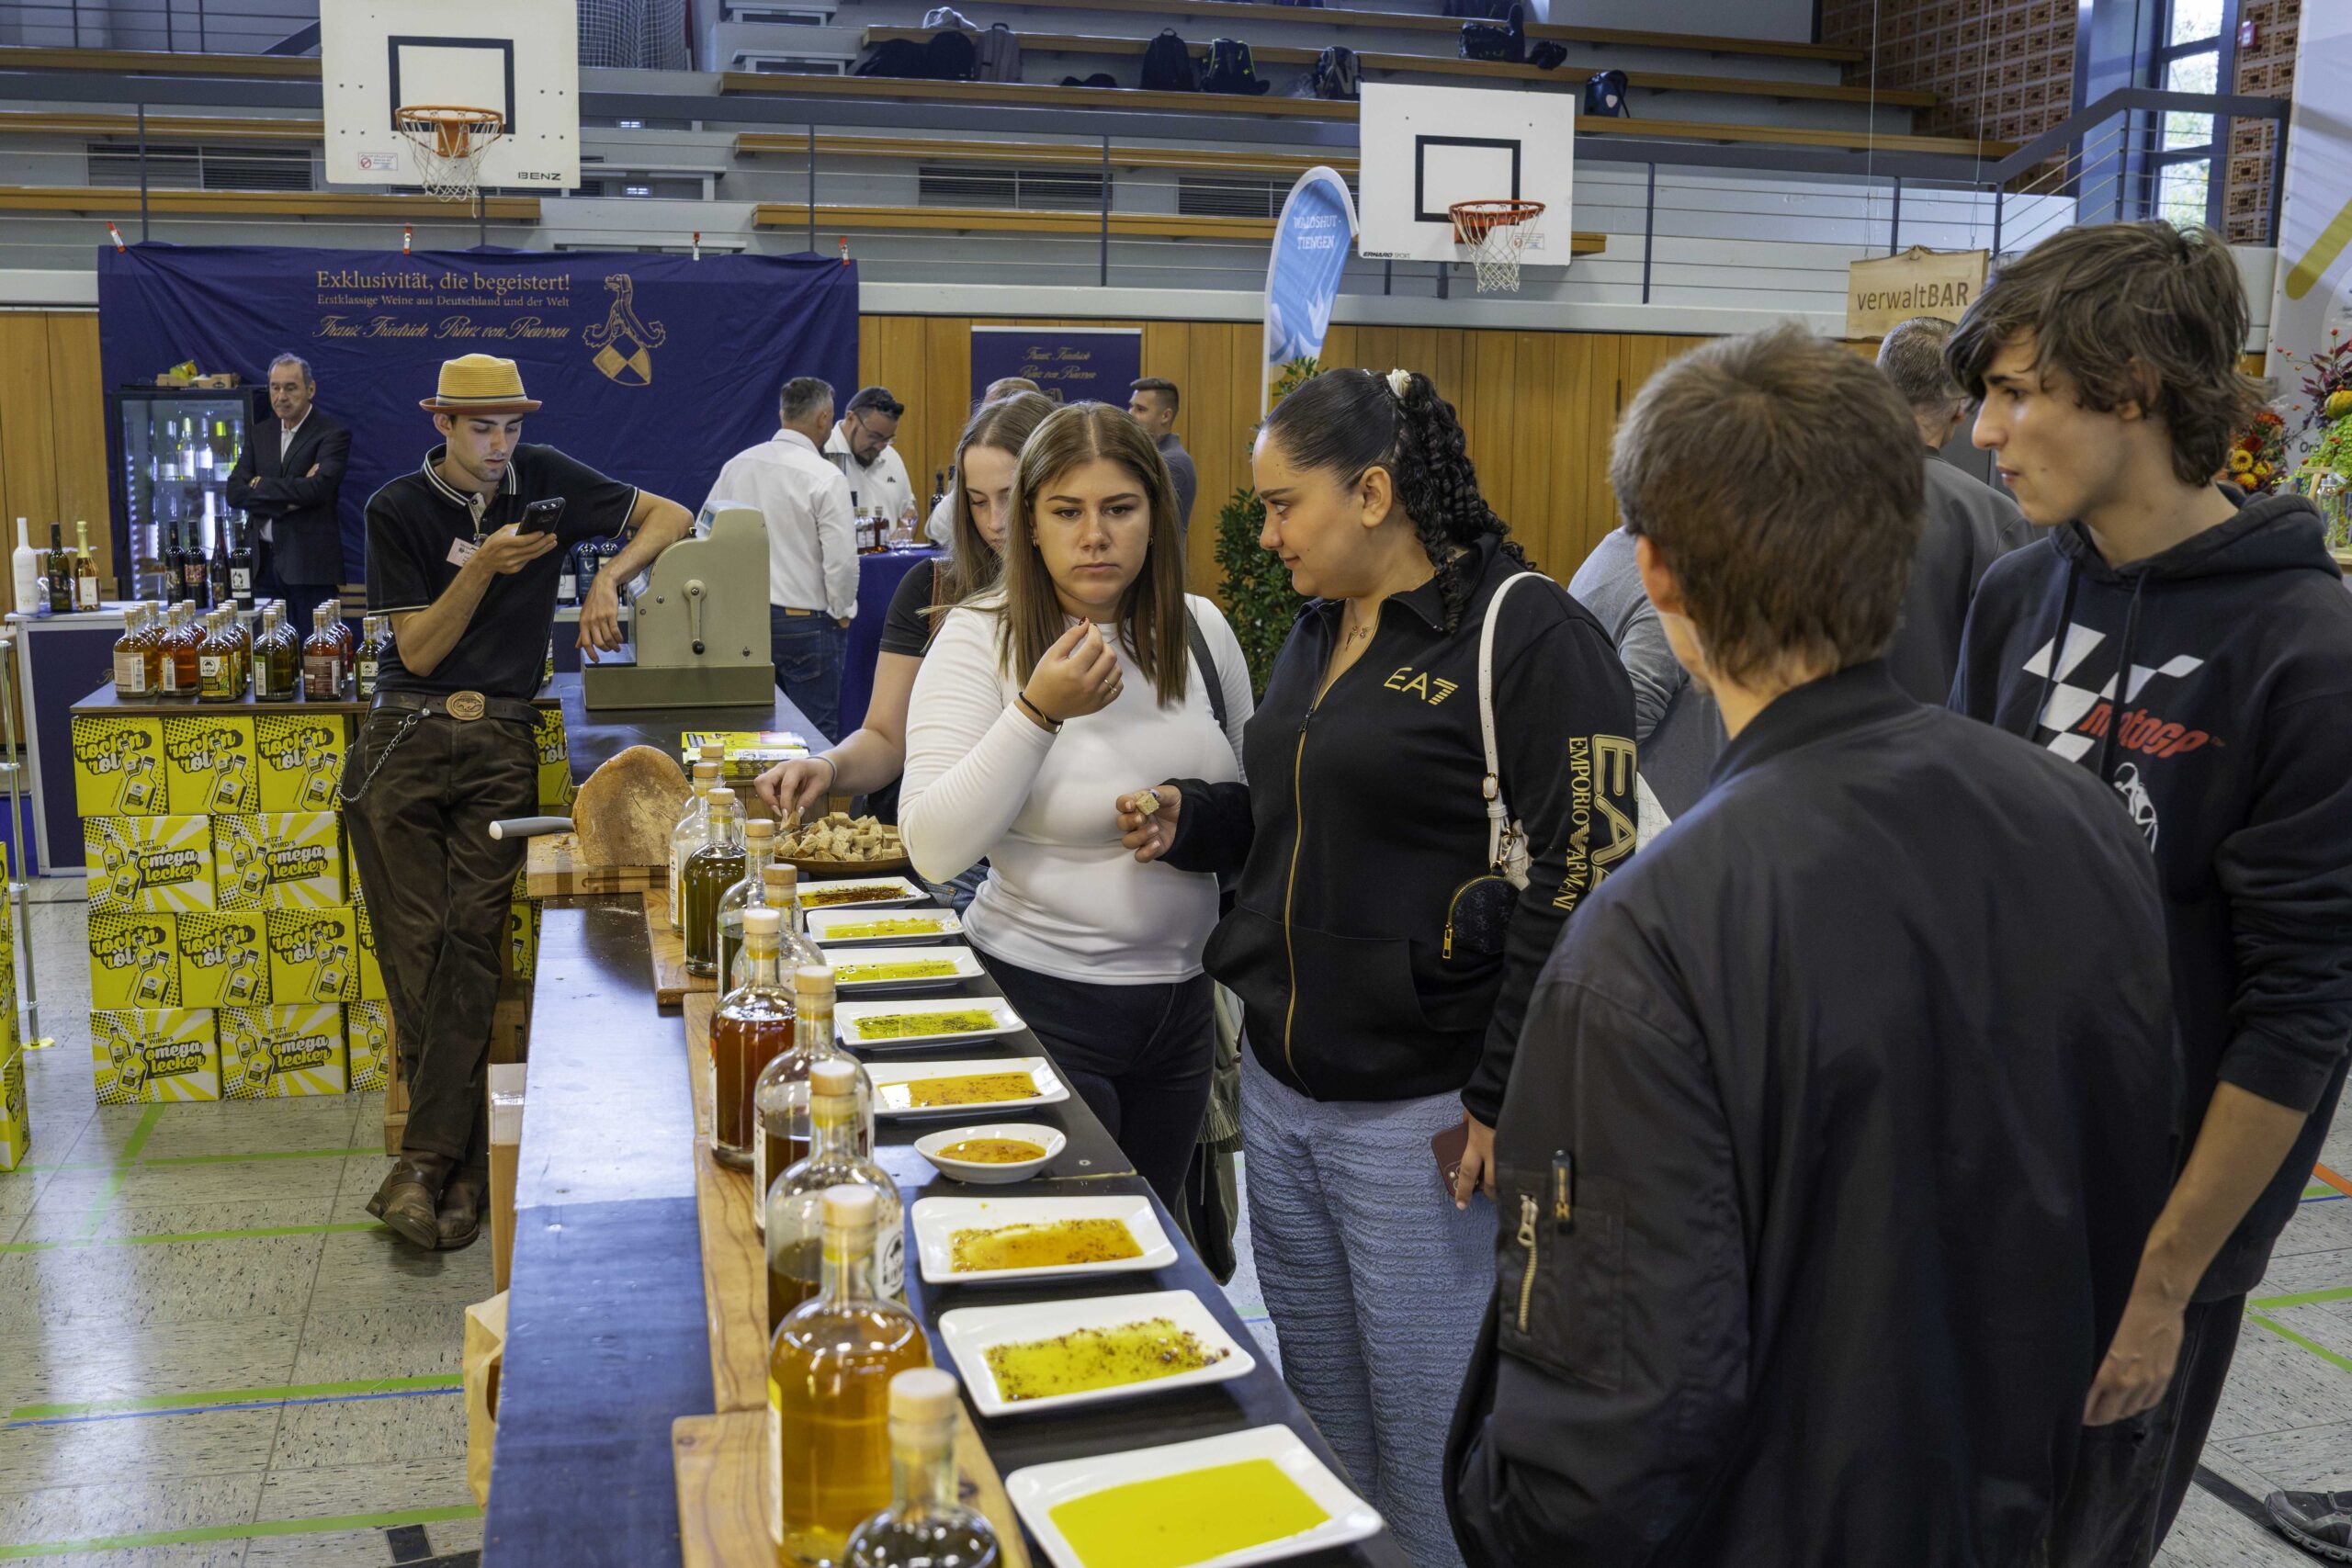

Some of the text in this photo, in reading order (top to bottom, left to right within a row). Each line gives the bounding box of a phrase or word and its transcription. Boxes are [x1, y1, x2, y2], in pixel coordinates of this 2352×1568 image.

[517, 171, 561, 181] BENZ
[1297, 235, 1335, 250] TIENGEN
[317, 270, 570, 295] Exklusivität, die begeistert!
[317, 294, 379, 308] Erstklassige
[381, 295, 413, 305] Weine
[436, 295, 501, 306] Deutschland
[503, 297, 524, 306] und
[526, 297, 544, 306] der
[547, 296, 570, 306] Welt
[1857, 282, 1969, 310] verwaltBAR
[1384, 667, 1459, 705] EA7
[1591, 734, 1638, 893] EA
[1553, 737, 1591, 912] EMPORIO ARMANI
[135, 839, 155, 847] JETZT
[142, 844, 169, 852] WIRD'S
[263, 836, 282, 844] JETZT
[270, 840, 296, 849] WIRD'S
[139, 850, 198, 869] omega
[266, 845, 325, 865] omega
[145, 863, 201, 882] lecker
[273, 859, 327, 878] lecker
[141, 1032, 161, 1040] JETZT
[267, 1026, 288, 1034] JETZT
[275, 1031, 300, 1040] WIRD'S
[149, 1036, 175, 1044] WIRD'S
[271, 1035, 329, 1055] omega
[145, 1041, 203, 1060] omega
[277, 1048, 332, 1067] lecker
[152, 1054, 206, 1073] lecker
